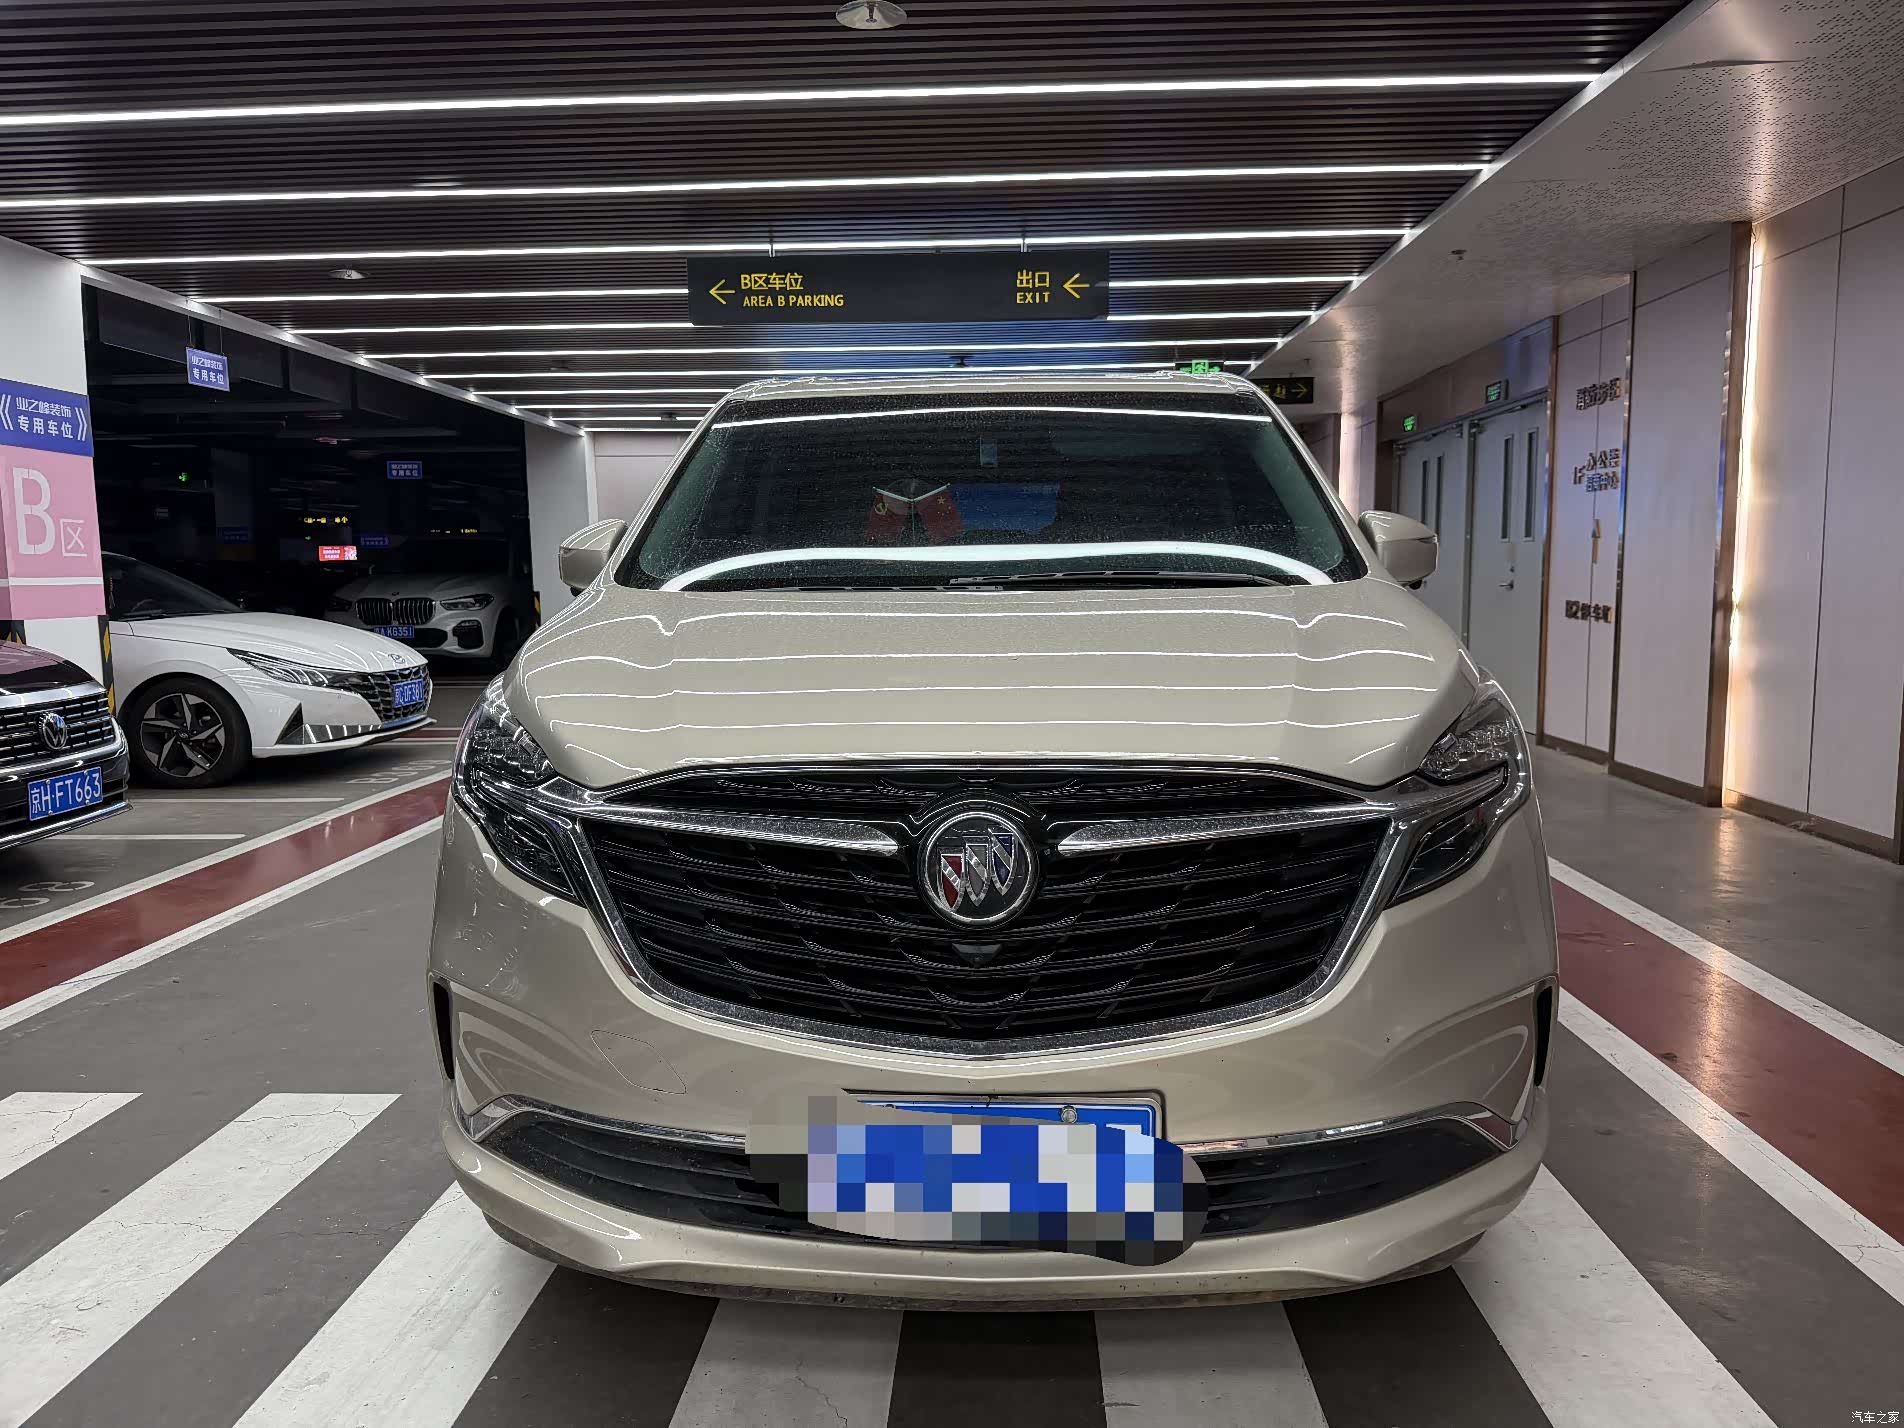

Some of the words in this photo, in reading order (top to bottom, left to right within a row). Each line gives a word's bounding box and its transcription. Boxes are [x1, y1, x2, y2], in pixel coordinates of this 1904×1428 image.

[740, 272, 804, 291] B区车位
[1016, 269, 1050, 289] 出口
[743, 295, 774, 307] AREA
[777, 295, 786, 307] B
[789, 294, 845, 307] PARKING
[1016, 291, 1051, 304] EXIT
[17, 414, 74, 439] 专用车位
[12, 466, 88, 557] B区
